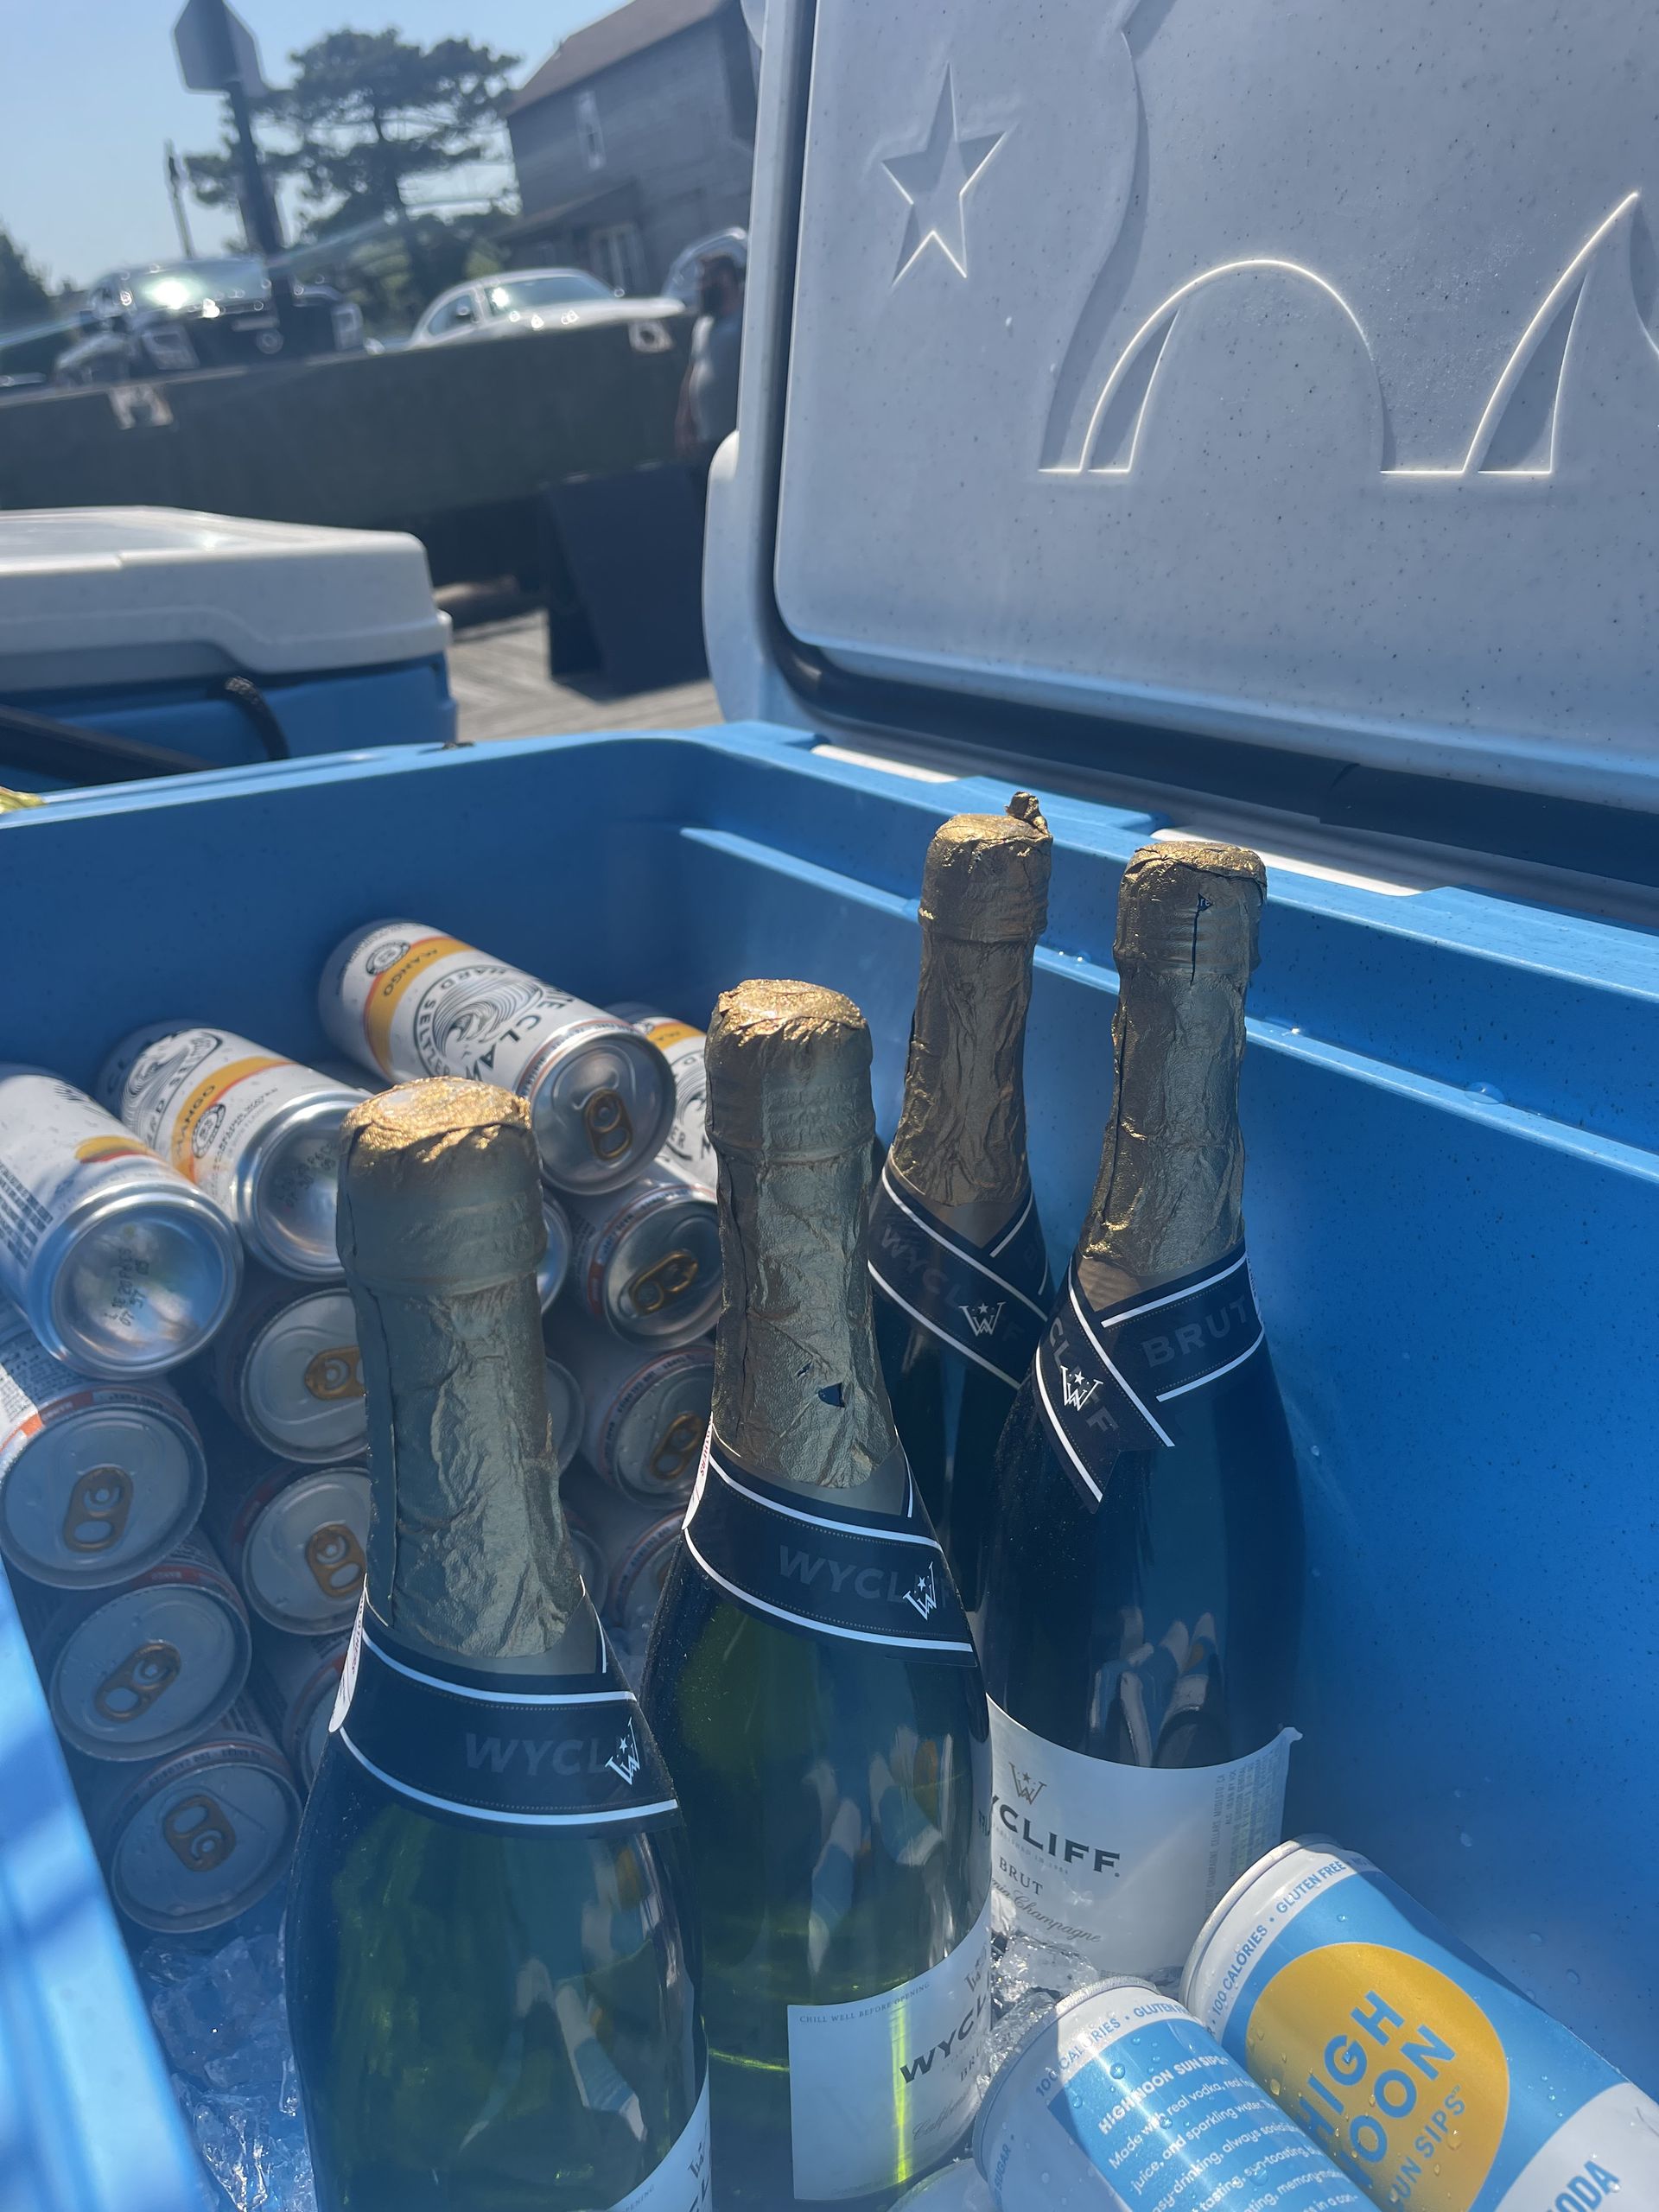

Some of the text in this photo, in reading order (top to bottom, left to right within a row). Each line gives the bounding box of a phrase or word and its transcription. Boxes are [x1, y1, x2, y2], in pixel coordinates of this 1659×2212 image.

[383, 948, 439, 998] MANGO
[416, 999, 452, 1077] SELTZER
[175, 1084, 217, 1158] MANGO
[1141, 1297, 1248, 1369] BRUT
[992, 1796, 1121, 1874] CLIFF
[999, 1856, 1044, 1896] BRUT
[1014, 1889, 1103, 1944] Champagne
[1212, 1859, 1347, 2015] 100 CALORIES GLUTEN FREE
[799, 1982, 931, 2024] CHILL WELL BEFORE OPENING
[1035, 2002, 1178, 2098] 100 CALORIES GLUTEN
[1299, 1989, 1406, 2151] HIGH
[1097, 2096, 1135, 2136] HIGH
[1131, 2069, 1175, 2103] NOON
[1173, 2056, 1203, 2075] SUN
[1109, 2134, 1143, 2171] Made
[1141, 2110, 1166, 2137] with
[1166, 2094, 1191, 2116] real
[1189, 2083, 1225, 2101] vodka,
[1224, 2077, 1243, 2089] real
[994, 2143, 1011, 2191] SUGAR
[1131, 2156, 1165, 2196] juice,
[1161, 2134, 1187, 2161] and
[1185, 2107, 1239, 2141] sparkling
[1152, 2149, 1224, 2212] asy-drinking,
[1221, 2129, 1262, 2154] always
[1199, 2175, 1247, 2212] tasting,
